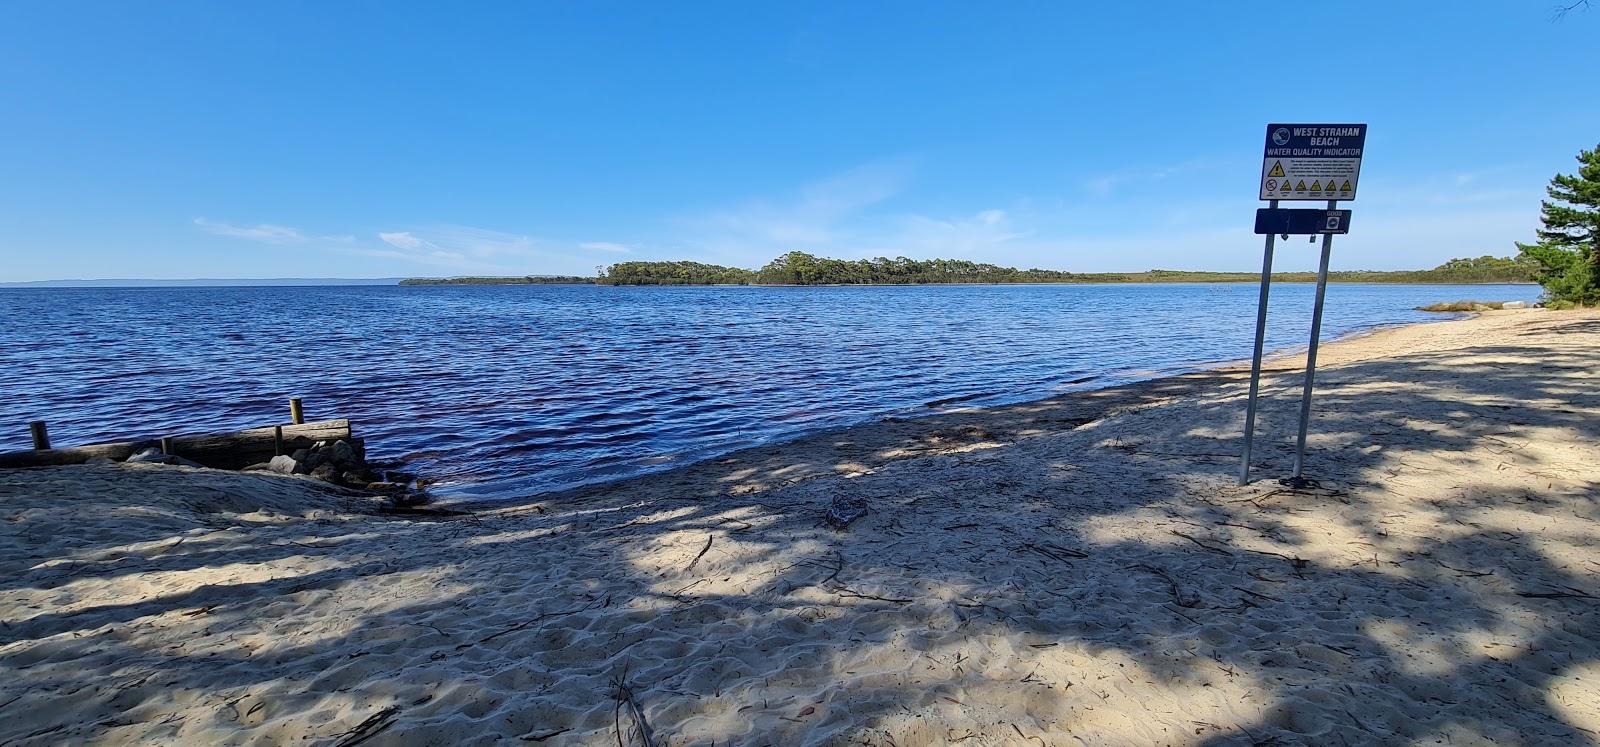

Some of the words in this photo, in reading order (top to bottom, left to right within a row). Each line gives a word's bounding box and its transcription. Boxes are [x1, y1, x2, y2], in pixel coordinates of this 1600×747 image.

[1293, 128, 1317, 136] WEST
[1319, 128, 1360, 136] STRAHAN
[1310, 137, 1340, 146] BEACH
[1292, 148, 1322, 156] QUALITY
[1323, 148, 1360, 156] INDICATOR
